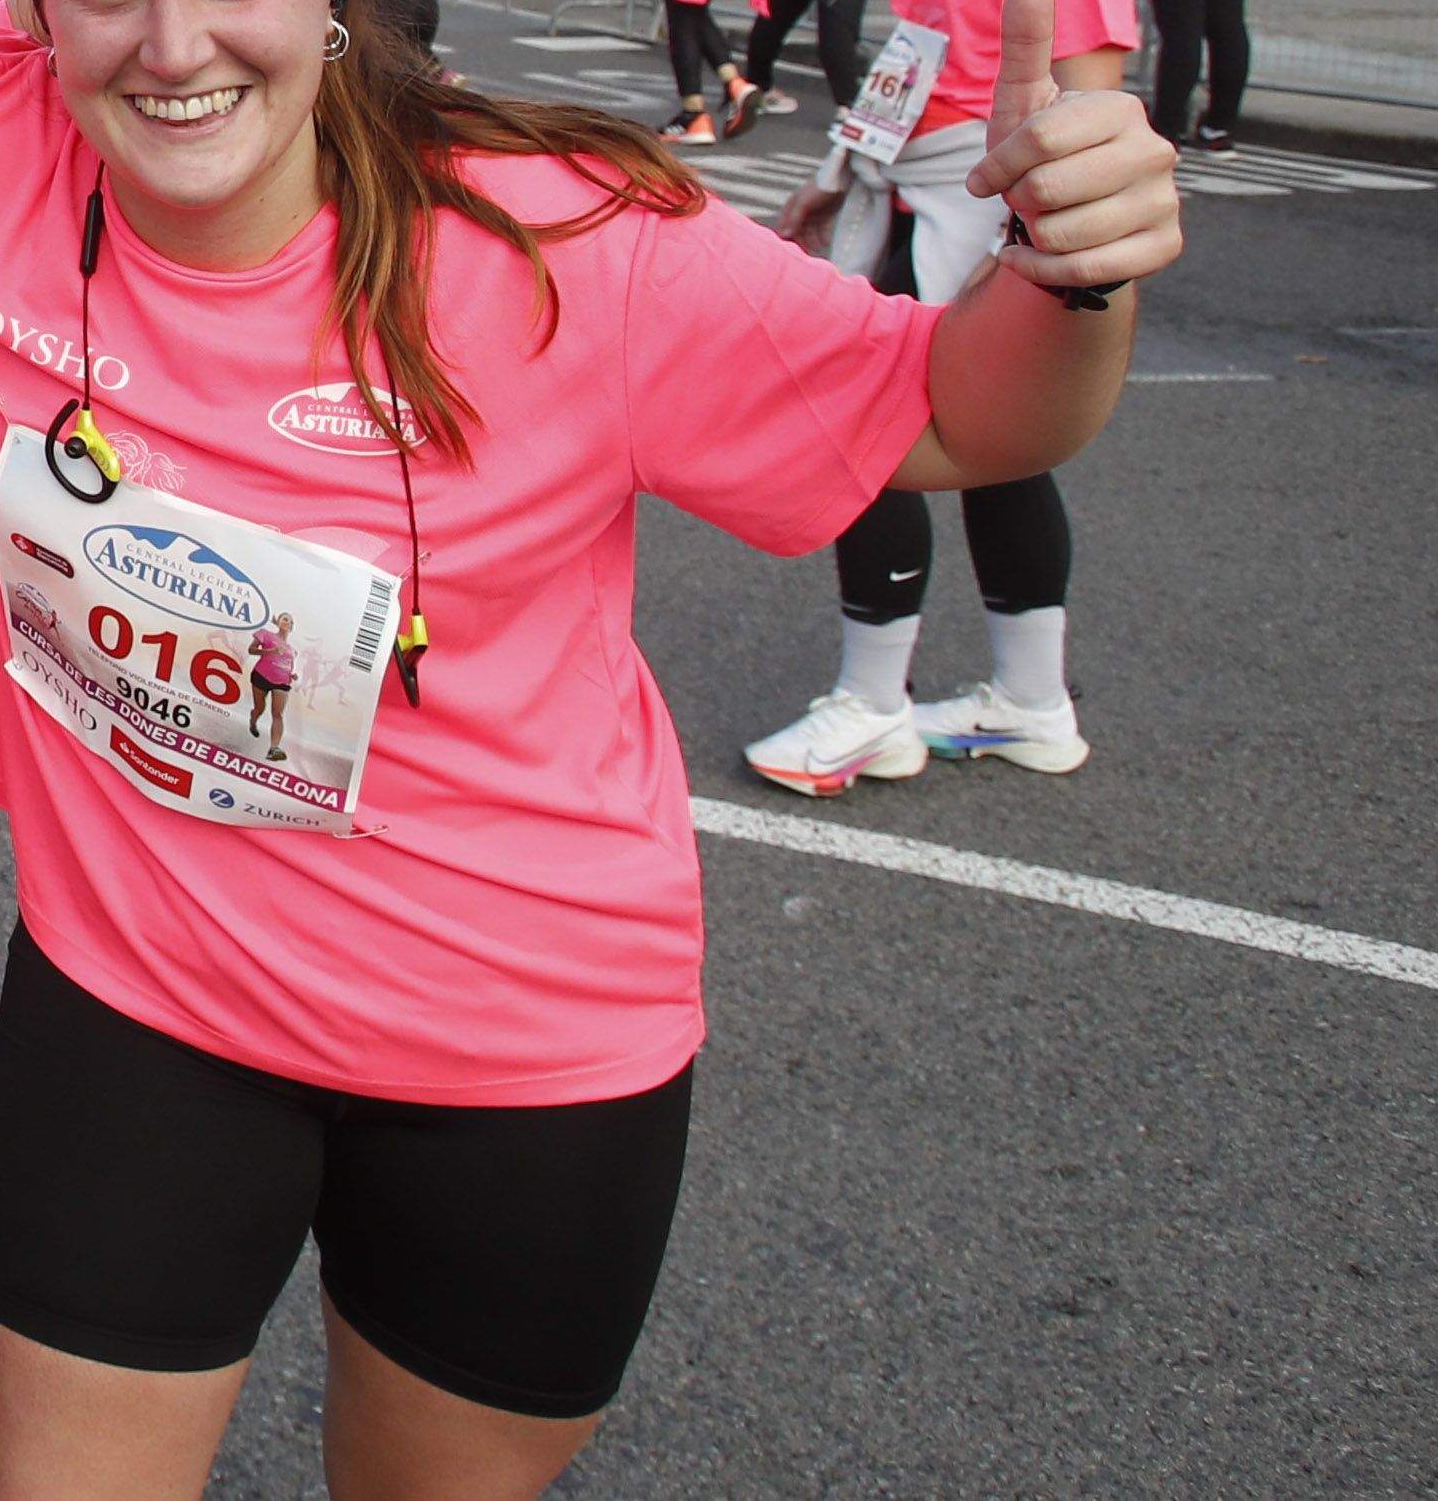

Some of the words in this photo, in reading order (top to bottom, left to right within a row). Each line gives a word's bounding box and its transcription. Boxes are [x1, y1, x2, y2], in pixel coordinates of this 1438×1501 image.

[94, 538, 252, 624] ASTURIANA
[126, 540, 185, 573] CENTRAL
[87, 605, 243, 705] 016
[19, 620, 63, 665] CURSA
[63, 661, 84, 686] DE
[85, 678, 117, 708] LES
[118, 697, 177, 746] DONES
[181, 737, 211, 761] DE
[213, 750, 340, 809] BARCELONA
[21, 650, 98, 731] OYSHO
[129, 749, 180, 786] Santander
[243, 803, 320, 827] ZURICH
[116, 675, 192, 729] 9046
